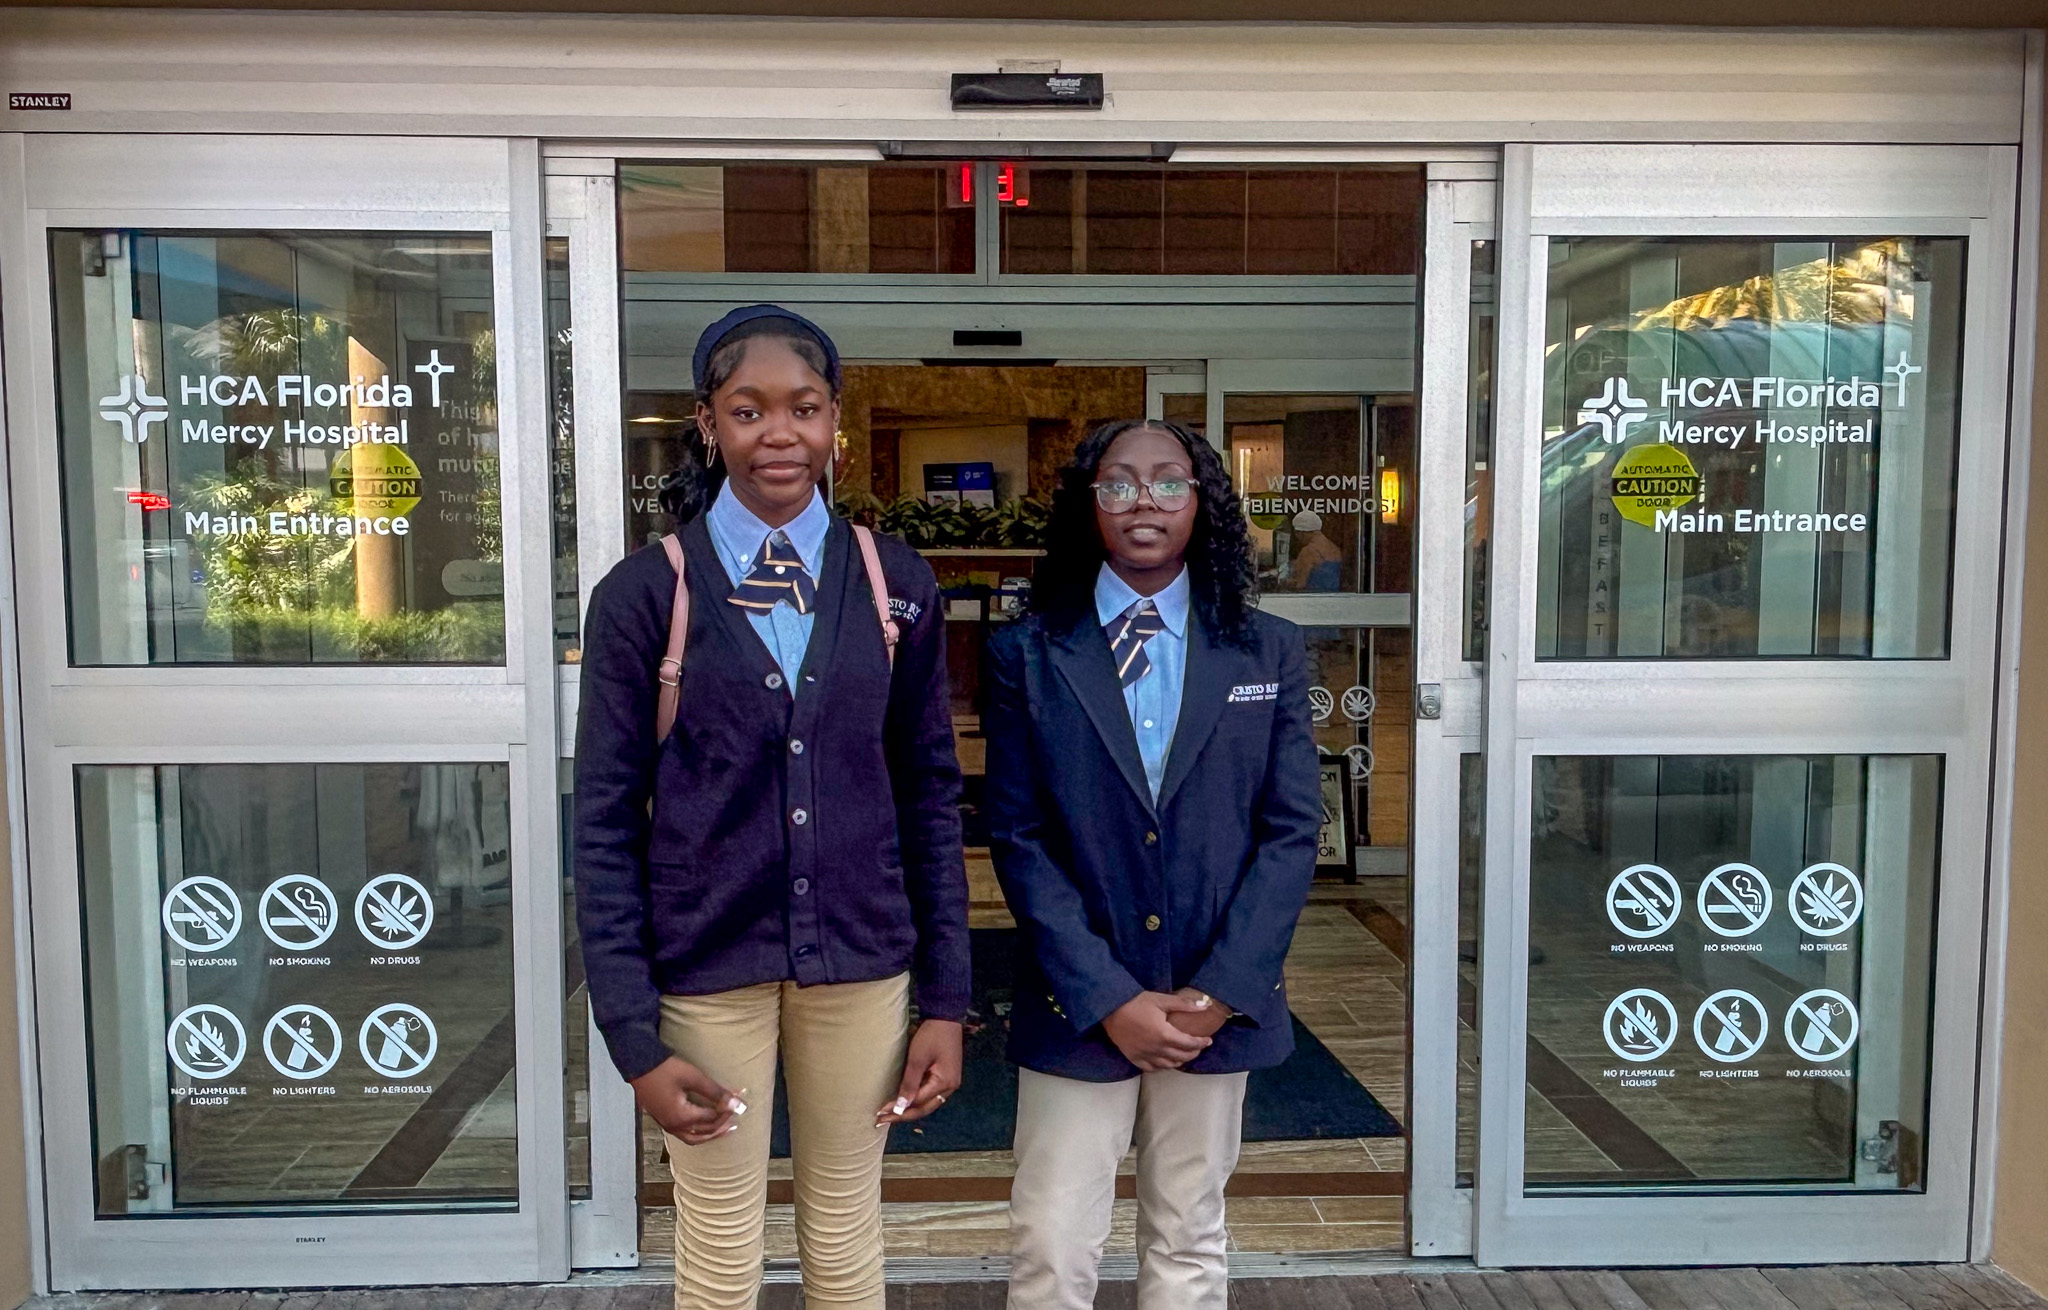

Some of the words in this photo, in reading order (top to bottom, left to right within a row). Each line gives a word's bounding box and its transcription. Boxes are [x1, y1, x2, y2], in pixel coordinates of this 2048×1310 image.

[11, 96, 69, 107] STANLEY
[180, 374, 269, 407] HCA
[277, 374, 414, 408] Florida
[1660, 376, 1743, 408] HCA
[1752, 376, 1880, 408] Florida
[181, 419, 275, 450] Mercy
[283, 418, 409, 450] Hospital
[1658, 420, 1747, 450] Mercy
[1754, 418, 1873, 449] Hospital
[1620, 464, 1690, 475] AUTOMATIC
[1267, 475, 1370, 492] WELCOME
[1616, 479, 1693, 494] CAUTION
[1636, 498, 1672, 508] DOOR
[185, 511, 259, 536] Main
[268, 511, 410, 536] Entrance
[1654, 508, 1723, 533] Main
[1734, 508, 1868, 533] Entrance
[887, 598, 907, 610] STO
[1627, 943, 1675, 953] WEAPONS
[1703, 943, 1719, 952] NO
[1720, 943, 1764, 952] SMOKING
[1800, 943, 1816, 952] NO
[1816, 943, 1848, 952] DRUGS
[187, 957, 239, 967] WEAPONS
[269, 956, 285, 967] NO
[286, 956, 332, 967] SMOKING
[370, 956, 386, 966] NO
[387, 955, 421, 966] DRUGS
[1603, 1068, 1618, 1078] NO
[1619, 1068, 1676, 1078] FLAMMABLE
[1715, 1069, 1760, 1078] LIGHTERS
[1786, 1069, 1801, 1078] NO
[1802, 1068, 1852, 1078] AEROSOLS
[1620, 1078, 1658, 1088] LIQUIDS
[171, 1086, 187, 1096] NO
[187, 1086, 248, 1096] FLAMMABLE
[272, 1086, 288, 1096] NO
[289, 1086, 337, 1096] LIGHTERS
[363, 1085, 380, 1095] NO
[381, 1085, 433, 1095] AEROSOLS
[190, 1096, 230, 1106] LIQUIDS
